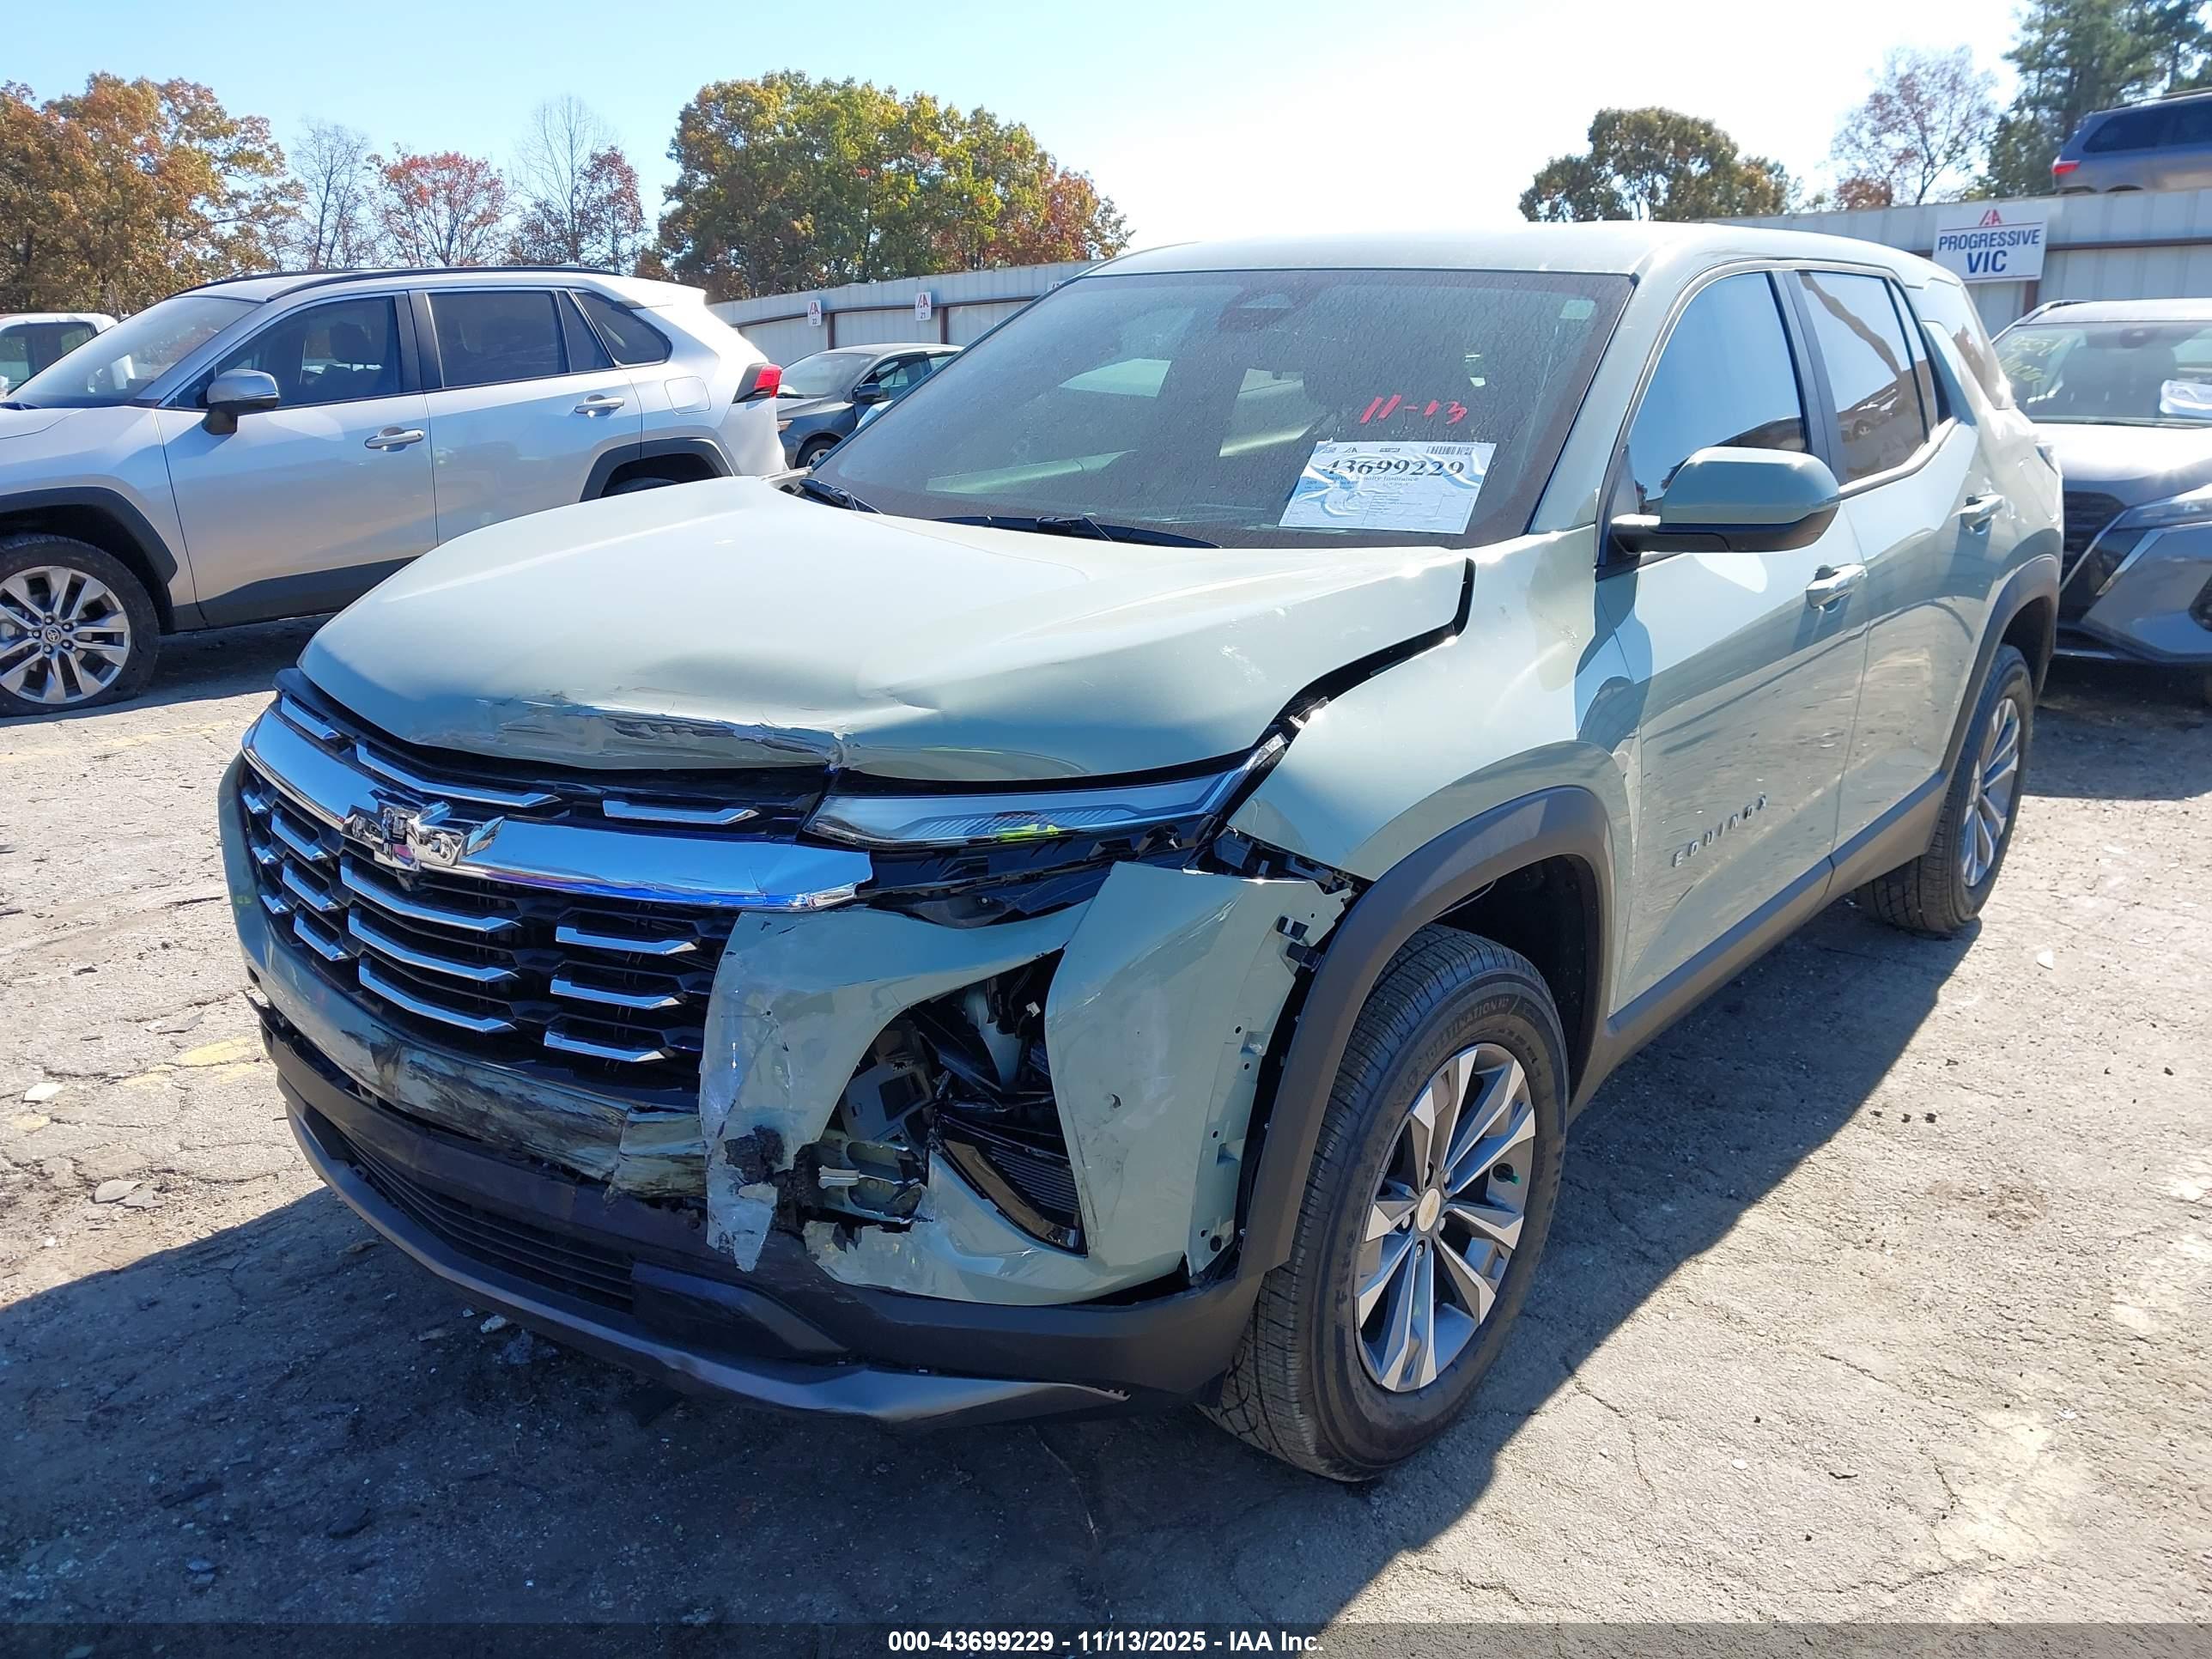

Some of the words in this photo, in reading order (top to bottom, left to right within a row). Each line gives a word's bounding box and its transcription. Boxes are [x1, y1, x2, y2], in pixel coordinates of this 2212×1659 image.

[1938, 228, 2041, 252] PROGRESSIVE
[1966, 250, 2008, 274] VIC
[1322, 459, 1465, 477] 43699229
[1672, 795, 1766, 868] EQUINOX
